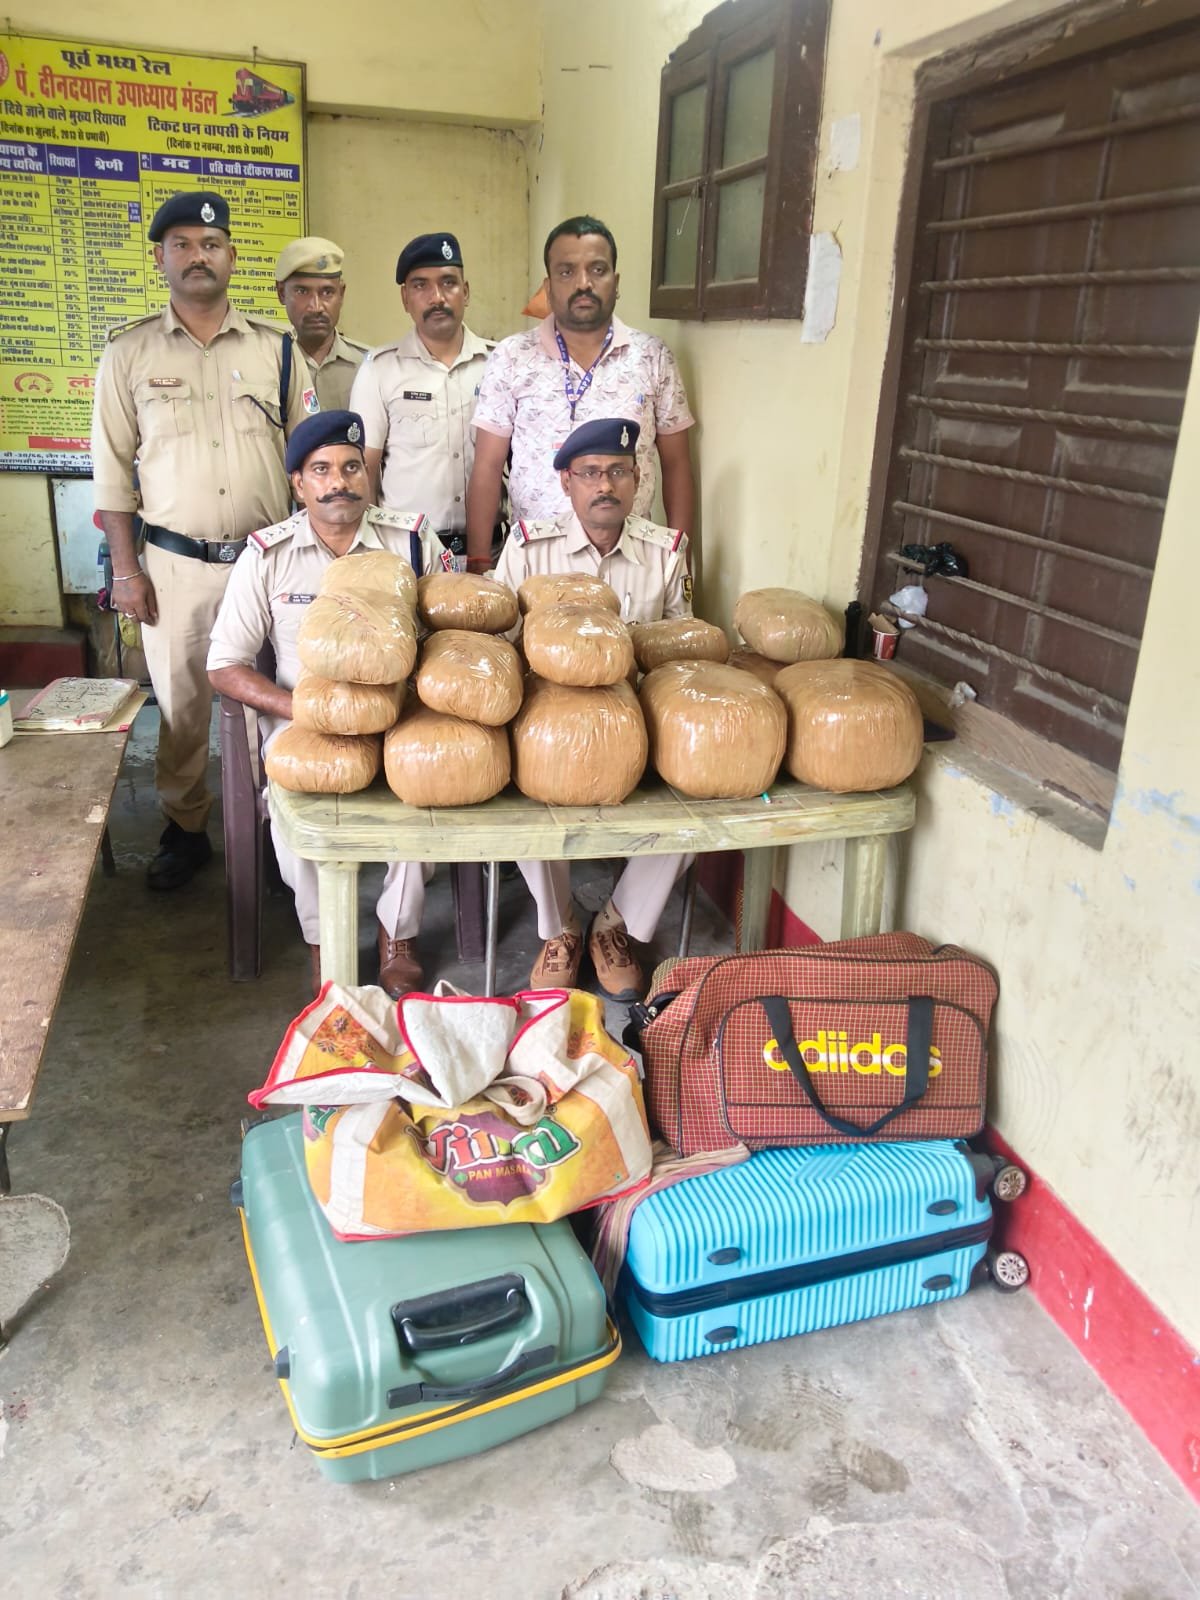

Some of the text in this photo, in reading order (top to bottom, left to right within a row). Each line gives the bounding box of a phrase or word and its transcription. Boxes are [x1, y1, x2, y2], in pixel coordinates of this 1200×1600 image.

[61, 49, 172, 76] पूर्व मध्य रेल
[15, 64, 218, 115] पं. दीनदयाल उपाध्याय मंडल
[25, 103, 45, 119] जाने
[47, 105, 66, 121] वाले
[69, 109, 91, 126] मुख्य
[93, 112, 127, 127] रियायत
[148, 115, 290, 143] टिकट धन वापसी के नियम
[166, 137, 192, 151] (दिनांक
[193, 140, 200, 151] 12
[243, 143, 250, 155] से
[49, 153, 76, 168] रियायत
[94, 157, 124, 172] श्रेणी
[161, 157, 191, 170] मद
[209, 160, 224, 175] प्रति
[225, 160, 242, 175] यात्री
[468, 1169, 493, 1182] PAN
